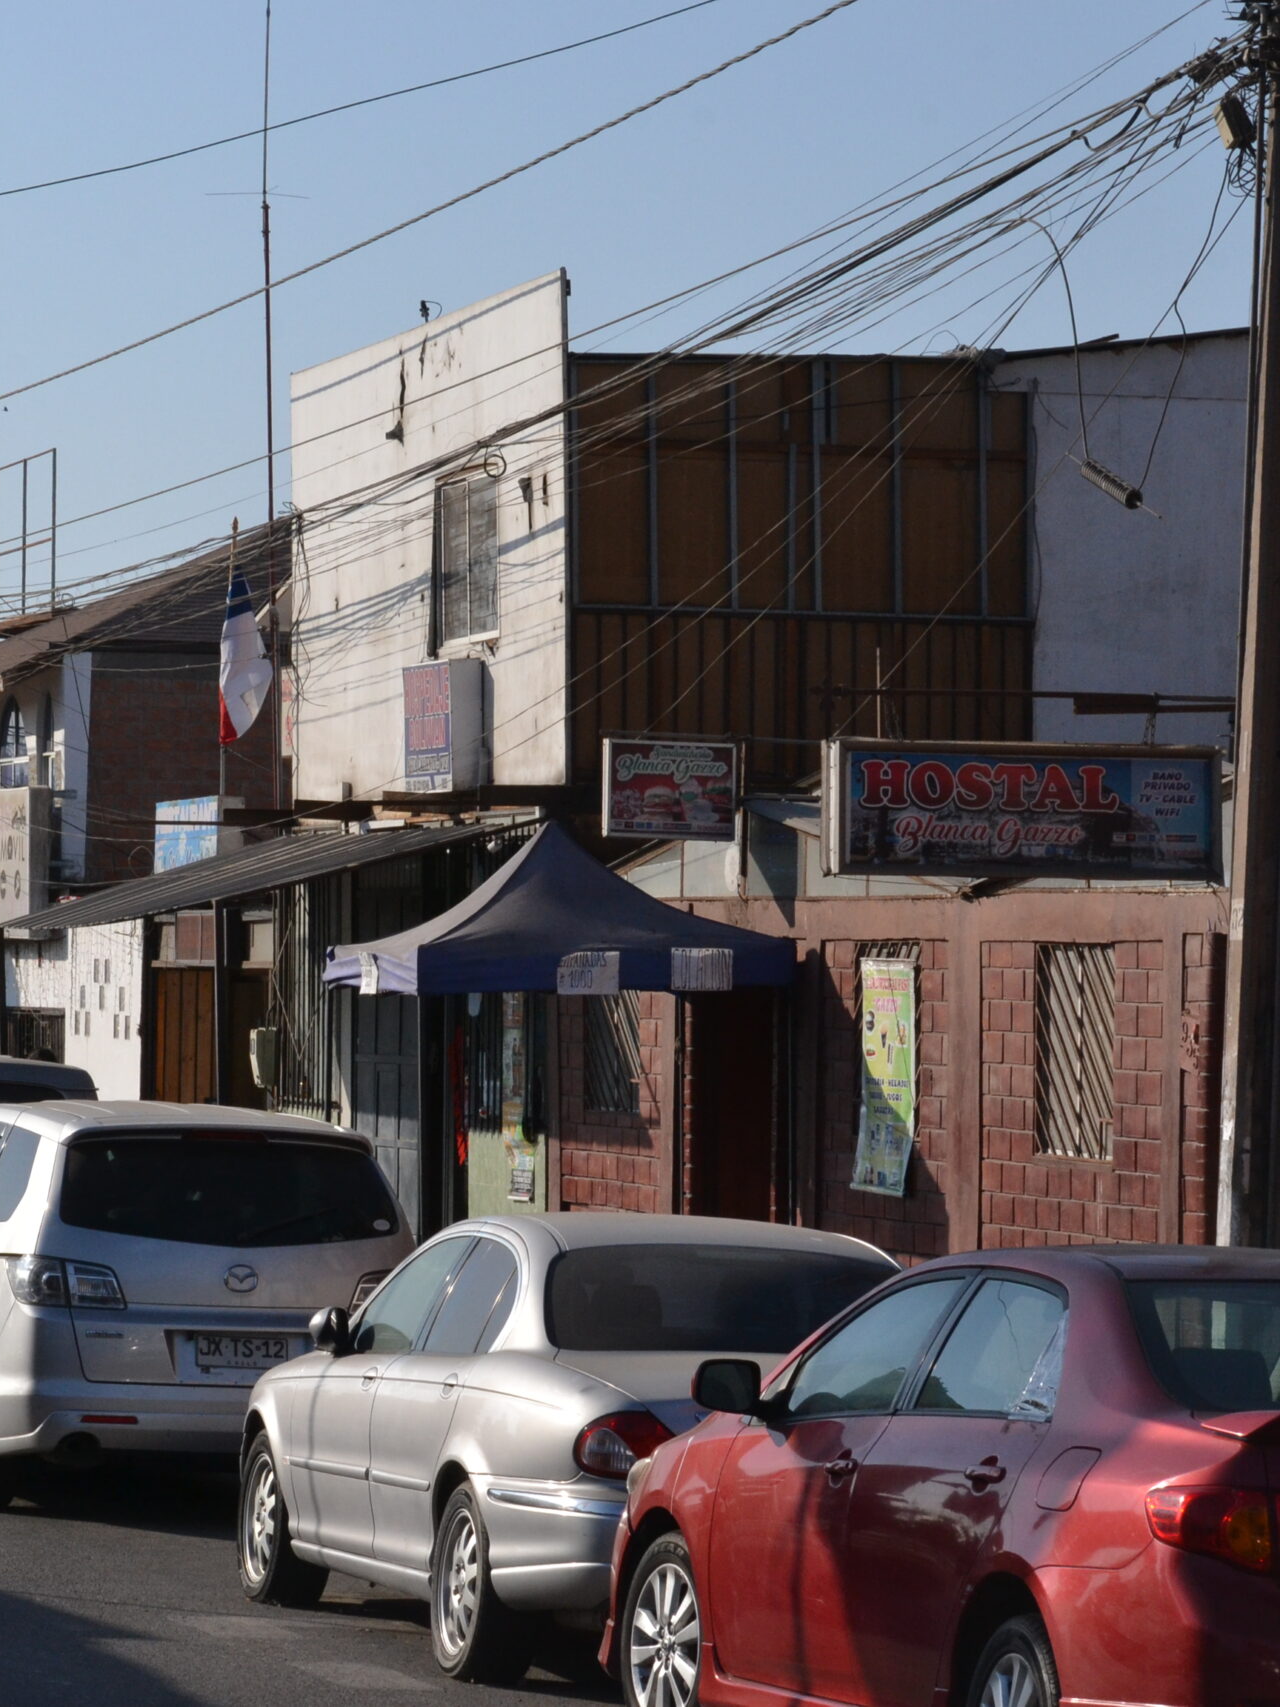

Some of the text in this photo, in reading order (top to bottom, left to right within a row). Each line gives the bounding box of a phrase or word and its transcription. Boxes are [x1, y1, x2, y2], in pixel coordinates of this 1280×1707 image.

[617, 754, 673, 781] Blanca
[861, 760, 1119, 813] HOSTAL
[1143, 782, 1191, 791] PRIVADO
[1140, 794, 1153, 803] TV
[1162, 794, 1196, 804] CABLE
[1155, 808, 1180, 816] WIFI
[895, 814, 1084, 857] Blanca Gazzo
